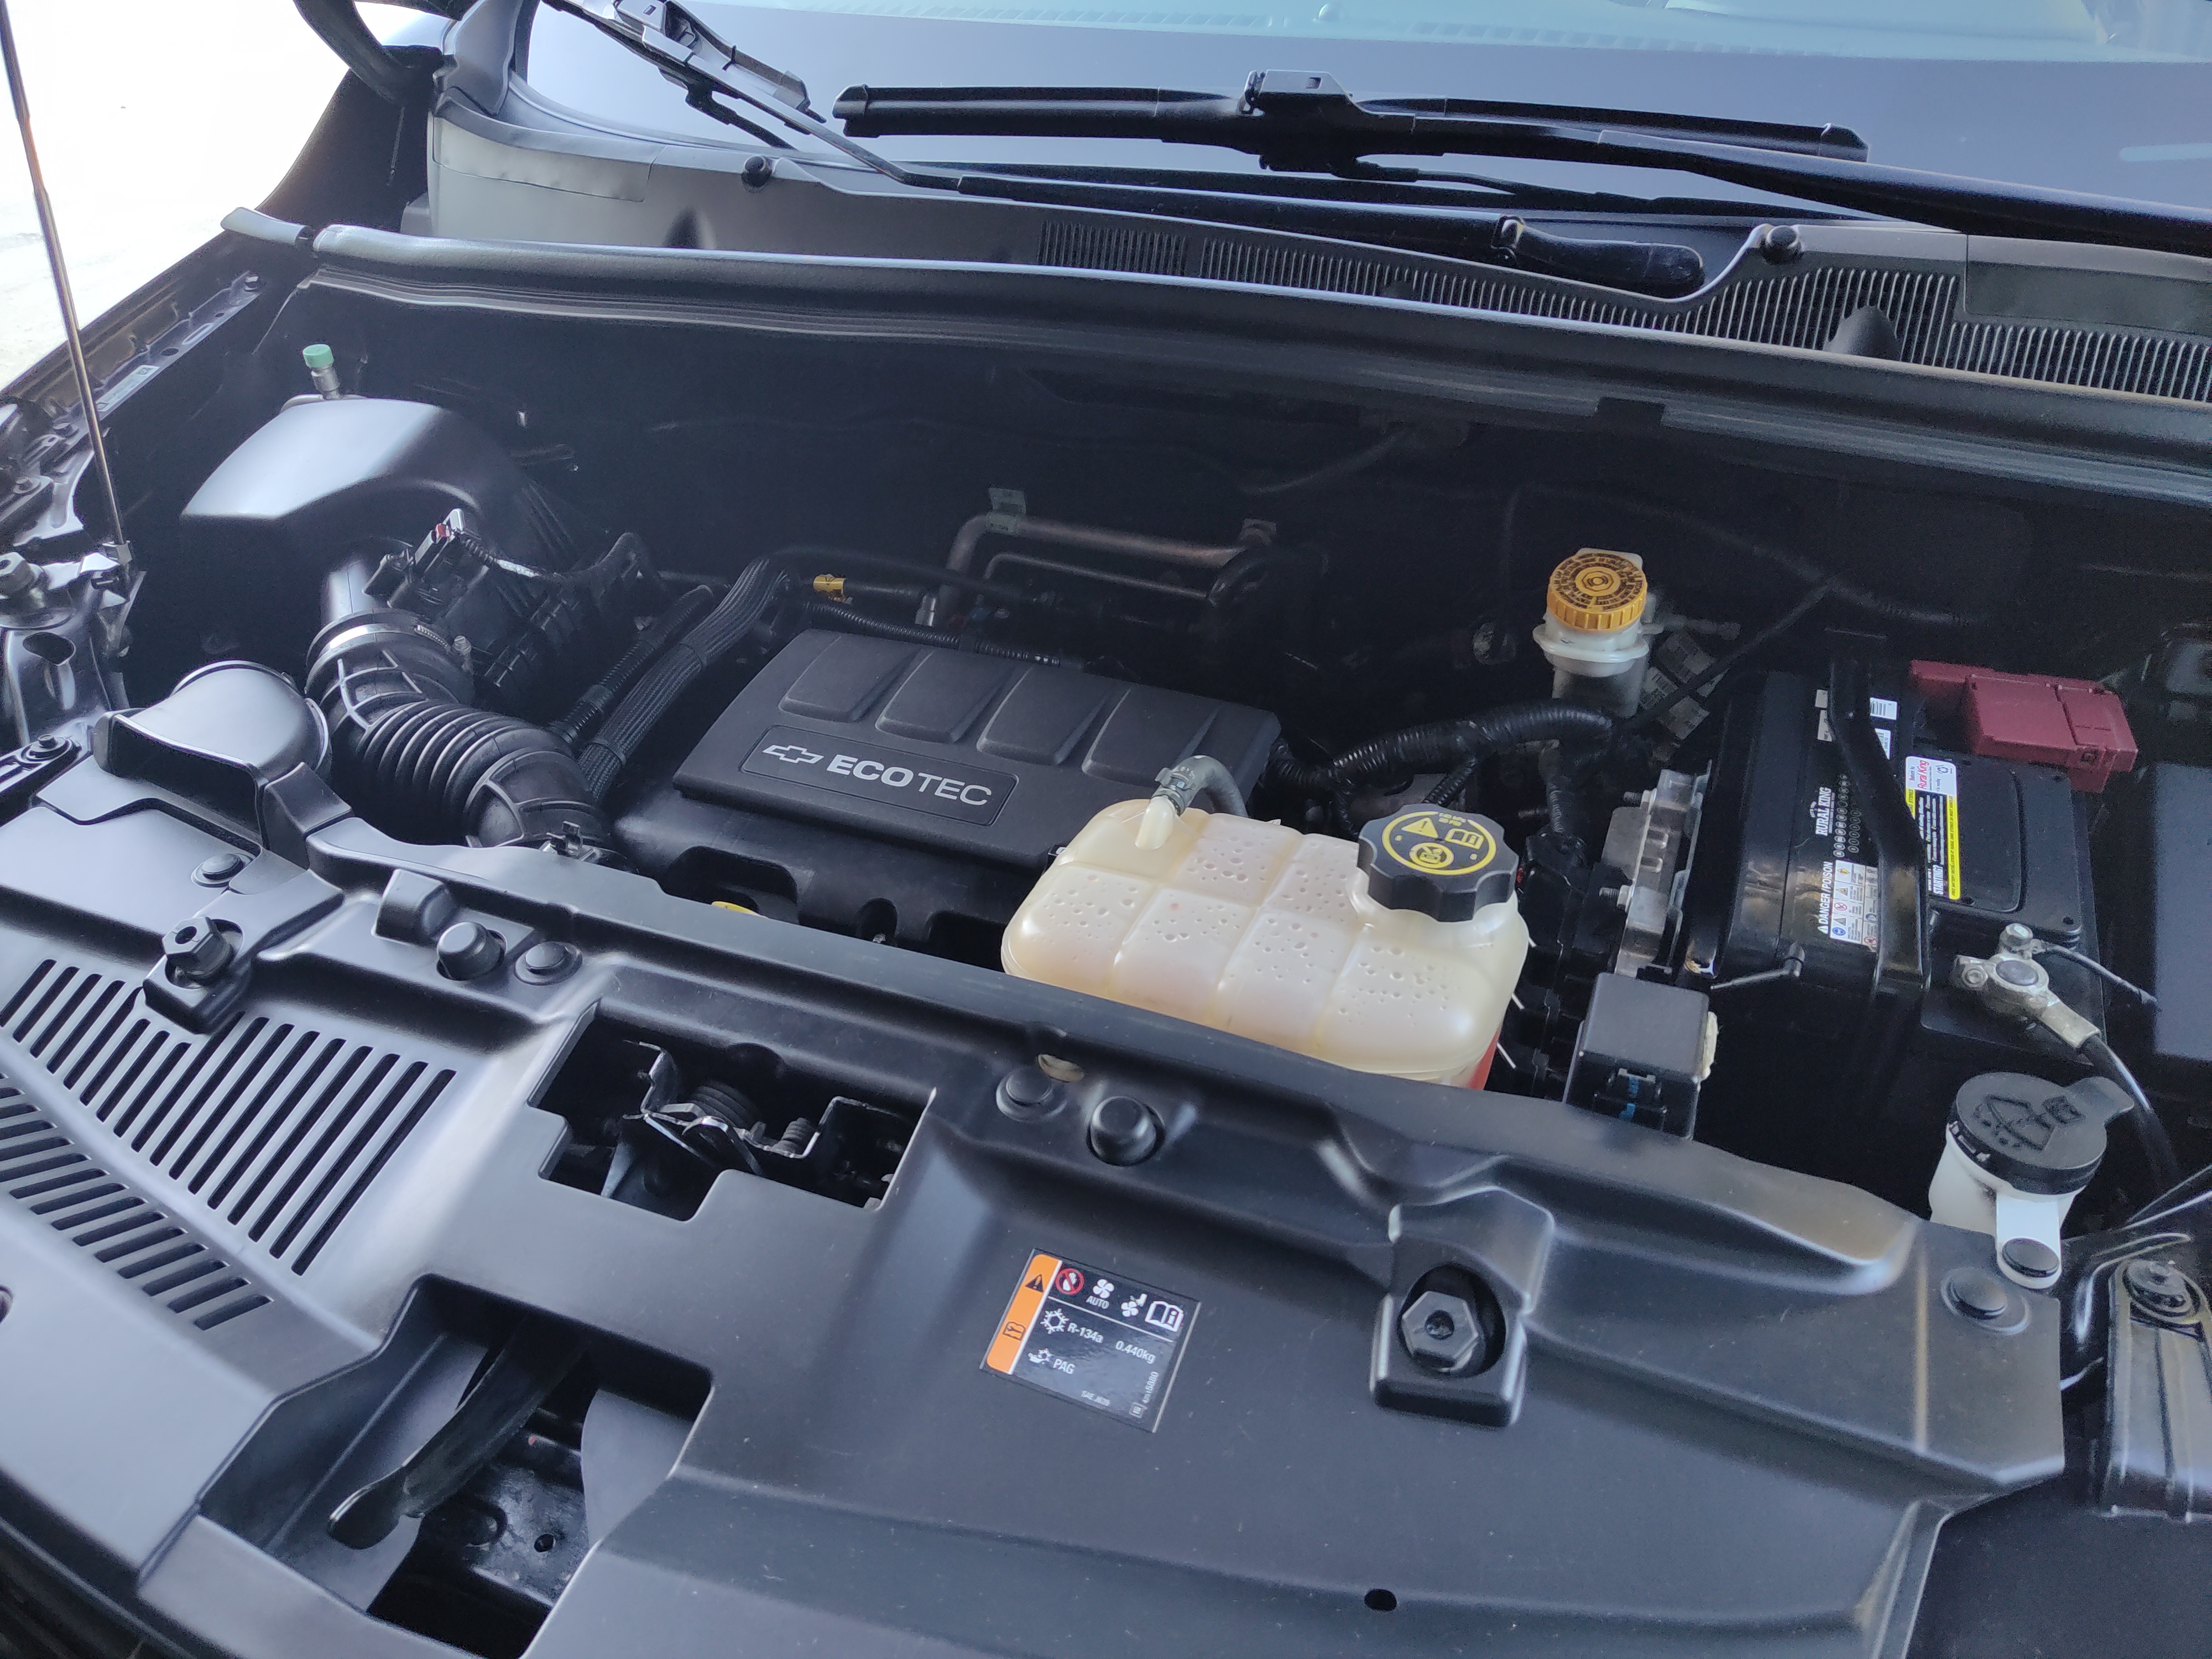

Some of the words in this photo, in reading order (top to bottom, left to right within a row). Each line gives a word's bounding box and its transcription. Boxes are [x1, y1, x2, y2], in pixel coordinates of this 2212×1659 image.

[1917, 760, 1929, 774] King
[826, 754, 992, 806] ECOTEC
[1917, 773, 1927, 789] Rural
[1818, 786, 1832, 807] KING
[1815, 808, 1830, 837] RURAL
[1933, 864, 1944, 895] STARTING?
[1818, 893, 1831, 925] DANGER
[1086, 1295, 1109, 1310] AUTO
[1067, 1322, 1104, 1344] R-134a
[1115, 1340, 1156, 1364] 0.440kg
[1053, 1358, 1076, 1375] PAG
